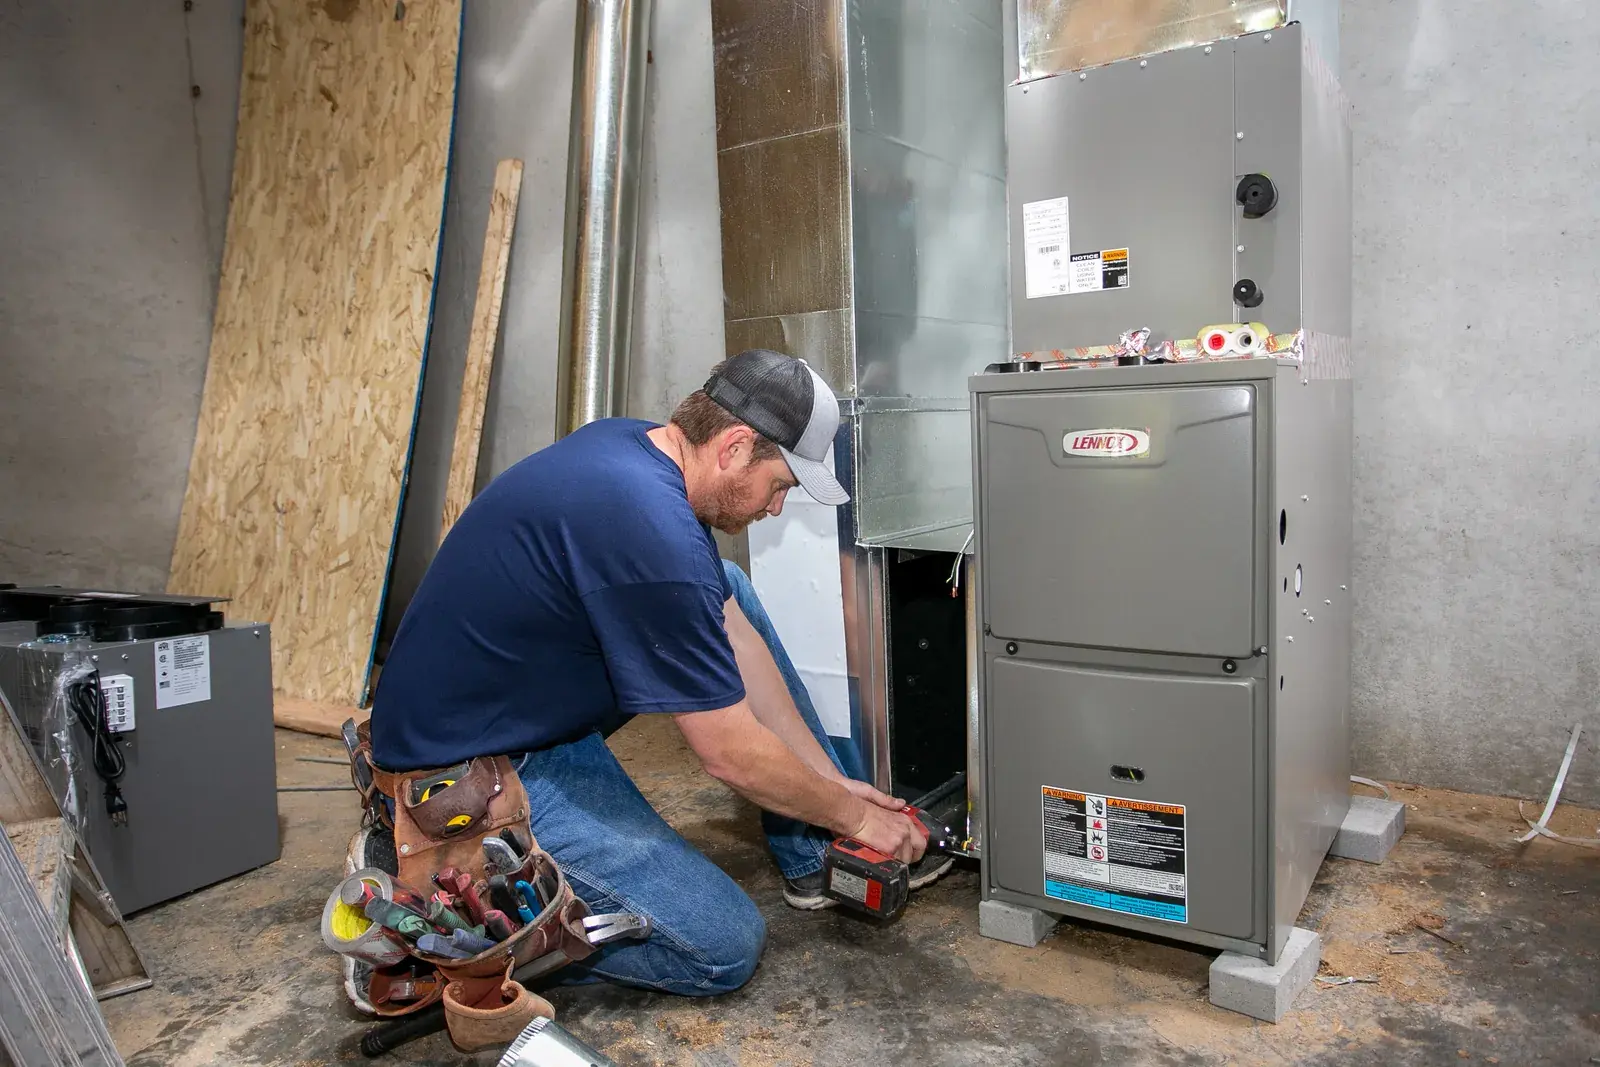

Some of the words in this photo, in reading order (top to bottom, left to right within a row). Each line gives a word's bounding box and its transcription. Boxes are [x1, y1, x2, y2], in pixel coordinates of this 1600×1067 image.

[1072, 253, 1099, 261] NOTICE
[1106, 251, 1127, 259] WARNING
[1072, 436, 1125, 450] LENNOX
[1051, 789, 1083, 801] WARNING
[1118, 800, 1179, 814] AVERTISSEMENT
